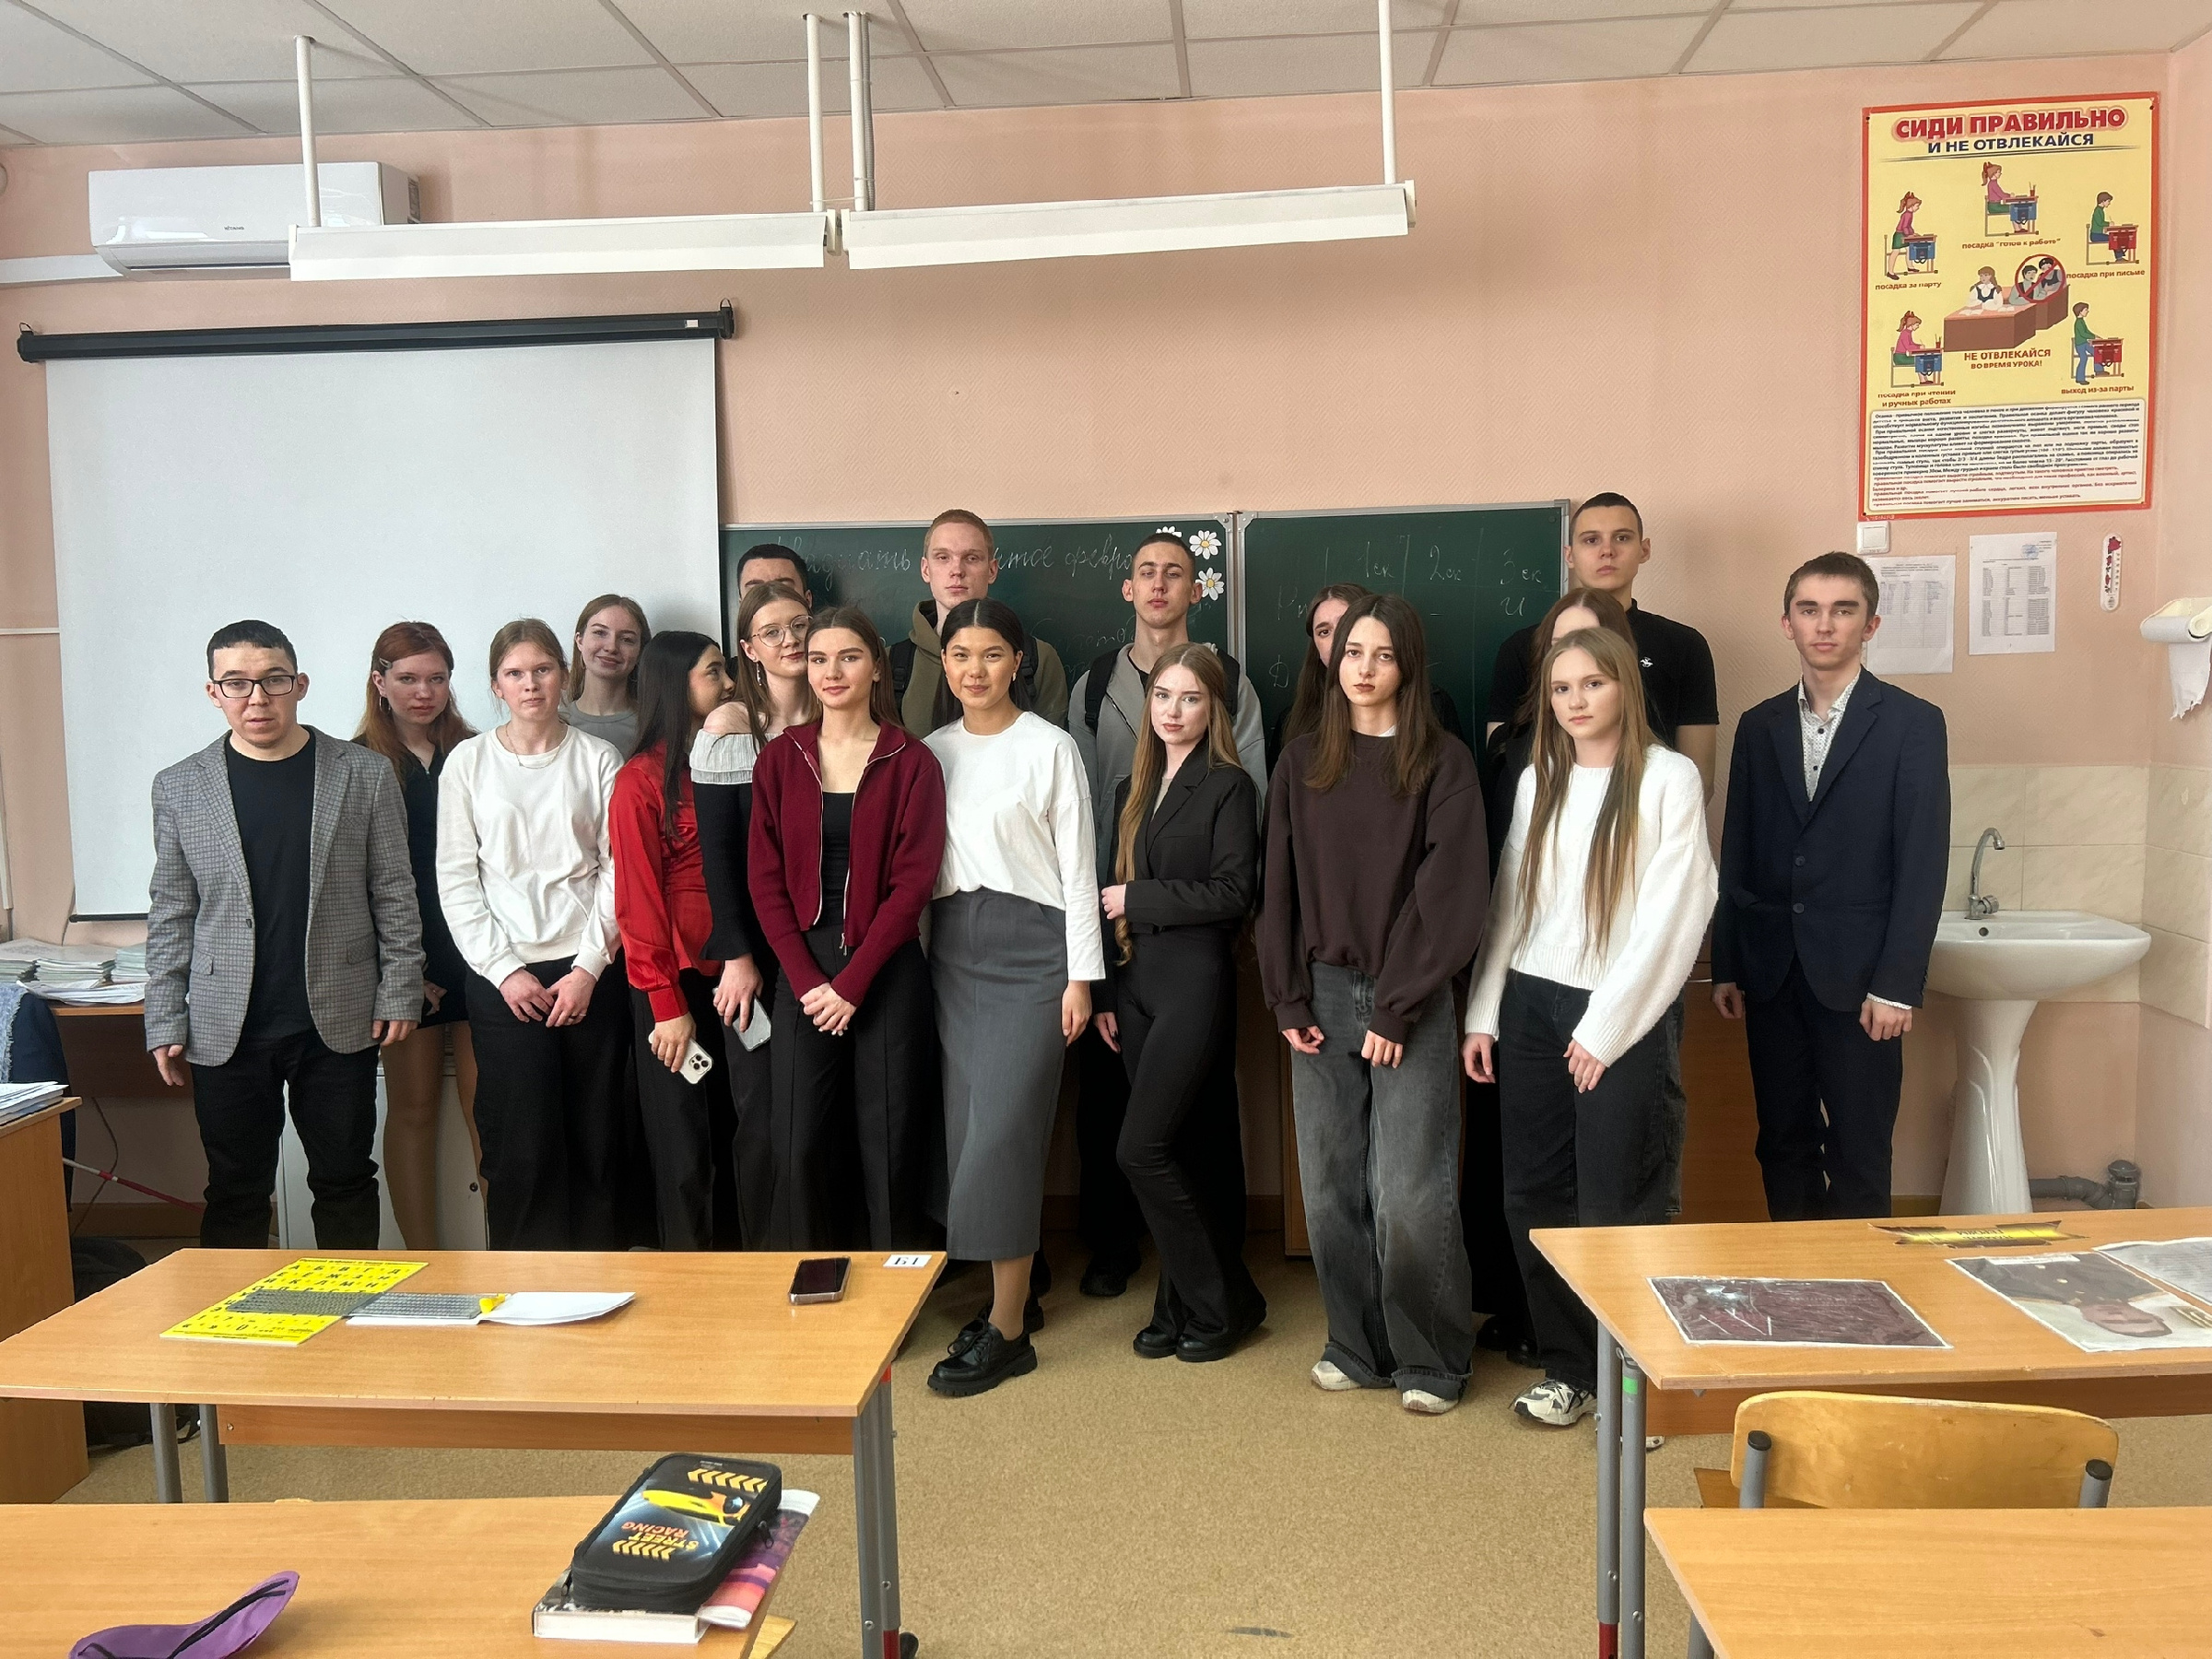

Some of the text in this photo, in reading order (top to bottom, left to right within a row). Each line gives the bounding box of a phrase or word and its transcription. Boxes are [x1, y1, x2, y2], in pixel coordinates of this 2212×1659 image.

[1897, 109, 2124, 139] СИДИ ПРАВИЛЬНО
[1928, 132, 2093, 153] И НЕ ОТВЛЕКАЙСЯ
[1981, 347, 2051, 359] ОТВЛЕКАЙСЯ
[2013, 359, 2042, 368] УРОКА!
[1920, 397, 1951, 406] работах
[621, 1522, 689, 1538] RACING
[629, 1532, 699, 1551] STREET
